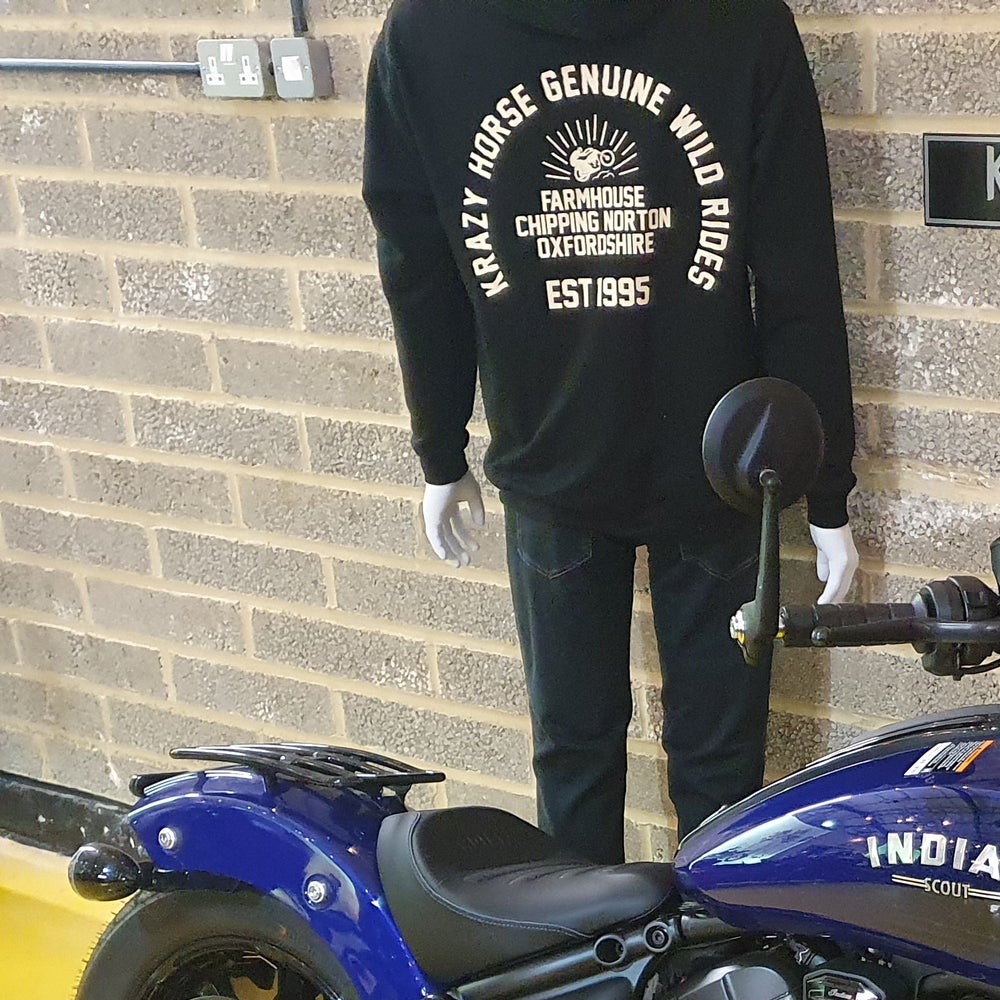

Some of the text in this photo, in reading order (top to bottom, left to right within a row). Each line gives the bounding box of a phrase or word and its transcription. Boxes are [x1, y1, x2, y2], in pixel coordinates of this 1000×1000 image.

[462, 64, 730, 298] KRAZY HORSE GENUINE WILD RIDES
[540, 185, 645, 212] FARMHOUSE
[515, 207, 672, 237] CHIPPING NORTON
[536, 232, 655, 259] OXFORDSHIRE
[545, 276, 650, 310] EST 1995
[924, 877, 970, 899] SCOUT
